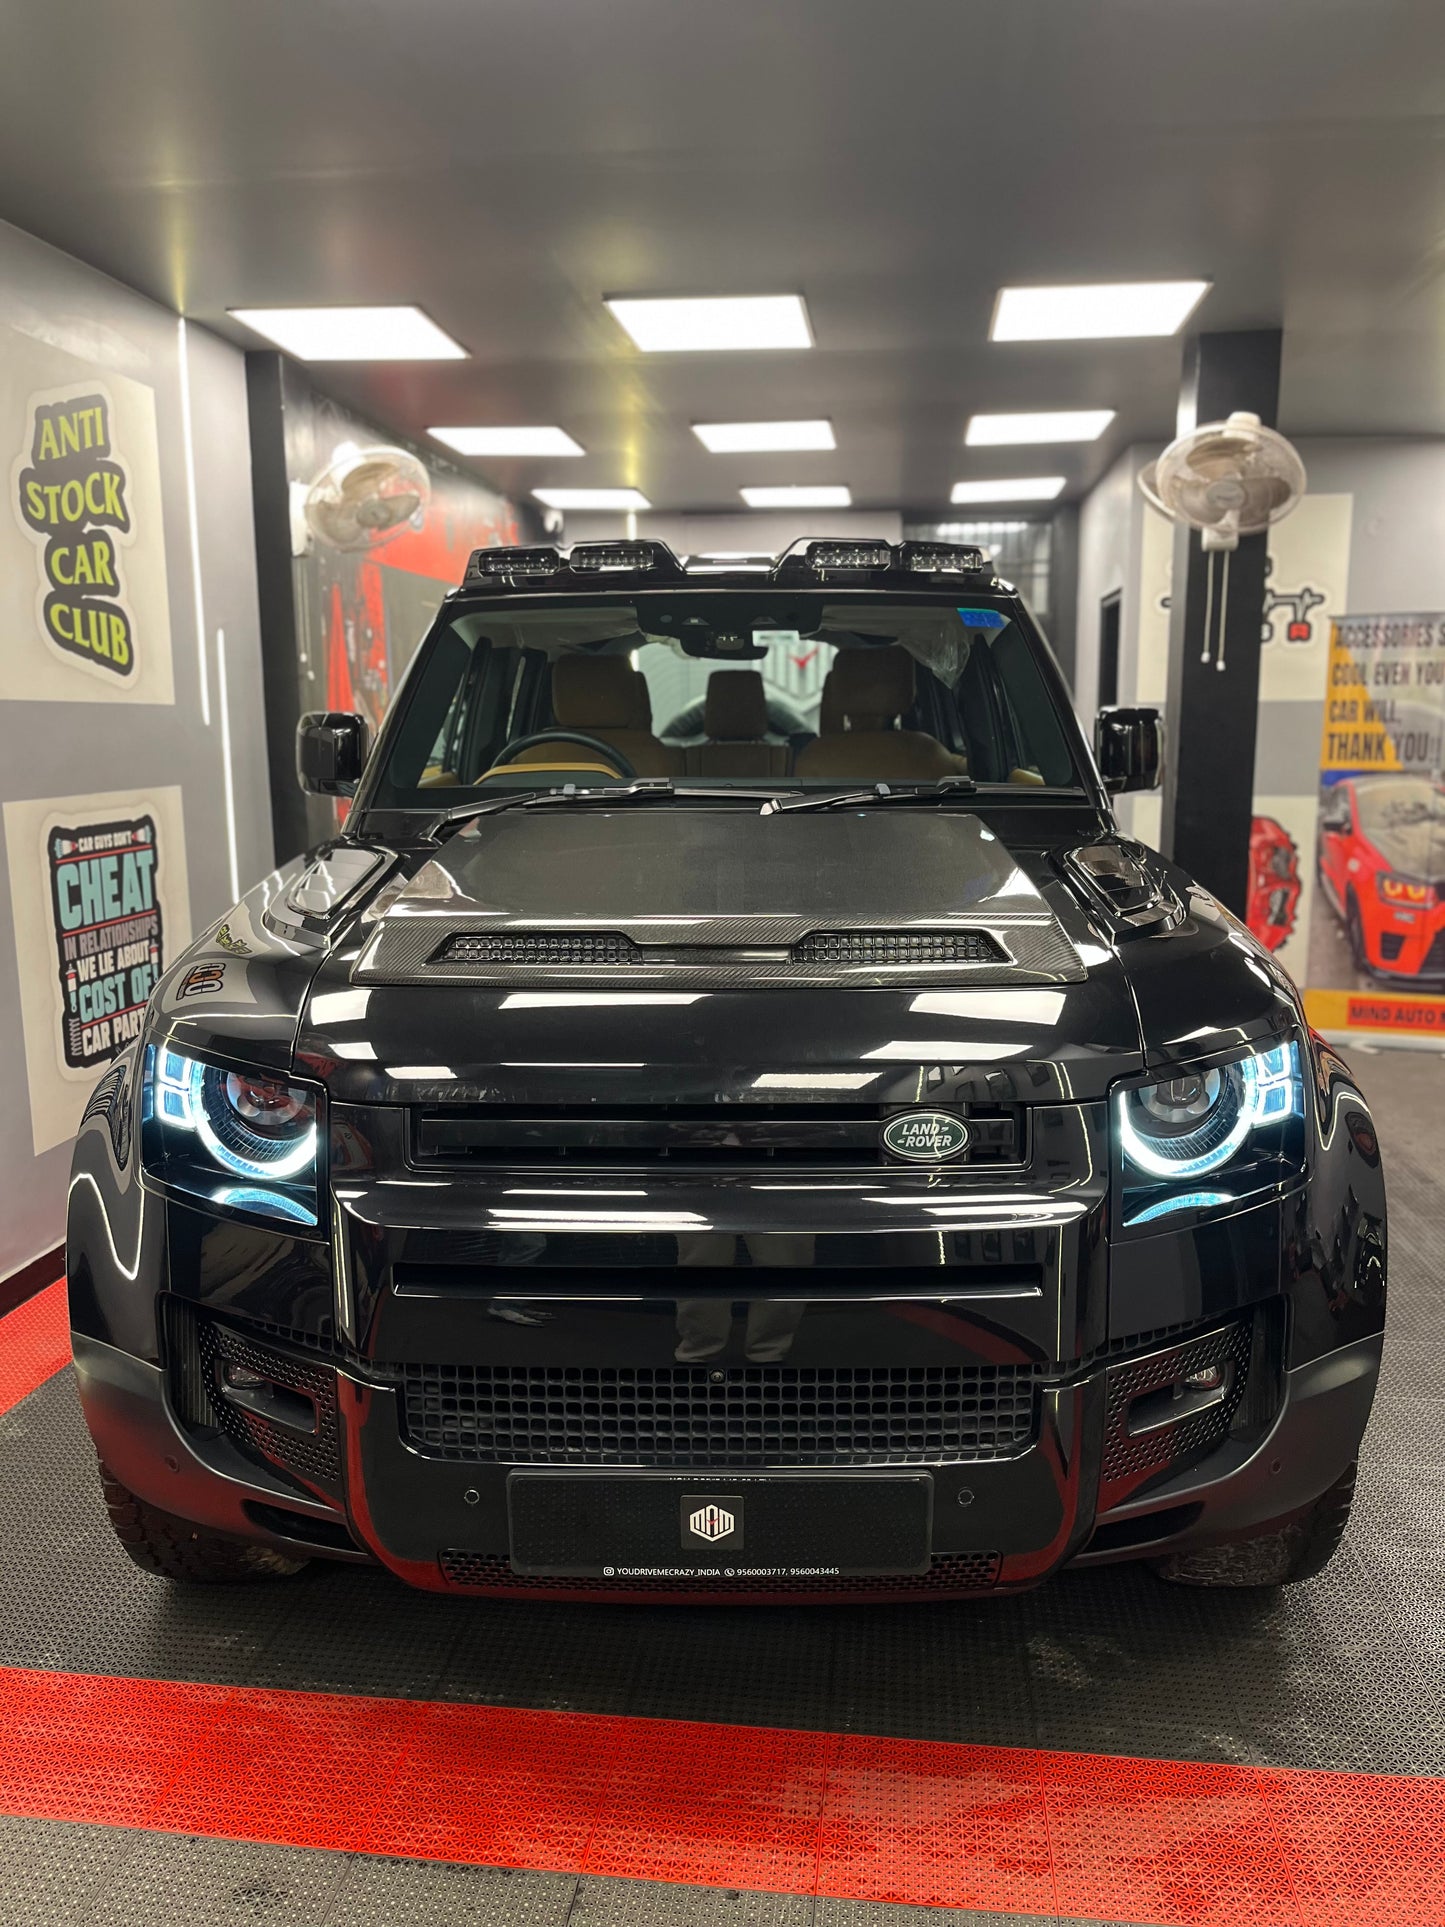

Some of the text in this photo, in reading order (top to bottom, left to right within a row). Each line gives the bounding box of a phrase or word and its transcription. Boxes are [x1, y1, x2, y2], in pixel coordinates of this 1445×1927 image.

[39, 406, 105, 461] ANTI
[26, 471, 125, 525] STOCK
[51, 540, 115, 586] CAR
[50, 603, 129, 666] CLUB
[1335, 622, 1434, 648] ACCESSORIES
[1332, 663, 1367, 686] COOL
[1374, 663, 1409, 686] EVEN
[1329, 698, 1358, 723] CAR
[1328, 732, 1387, 762] THANK
[78, 835, 94, 853] CAR
[94, 833, 113, 851] GUYS
[56, 848, 154, 931] CHEAT
[63, 914, 159, 962] IN RELATIONSHIPS
[76, 939, 150, 983] WE LIE ABOUT
[79, 963, 152, 1024] COST OF
[1352, 1005, 1390, 1021] MIND
[1395, 1006, 1437, 1025] AUTO
[82, 1021, 112, 1057] CAR
[903, 1124, 940, 1135] LAND
[905, 1135, 952, 1147] ROVER
[616, 1567, 721, 1577] YOUDRIVEMECRAZY_INDIA
[790, 1567, 840, 1576] 9560043445
